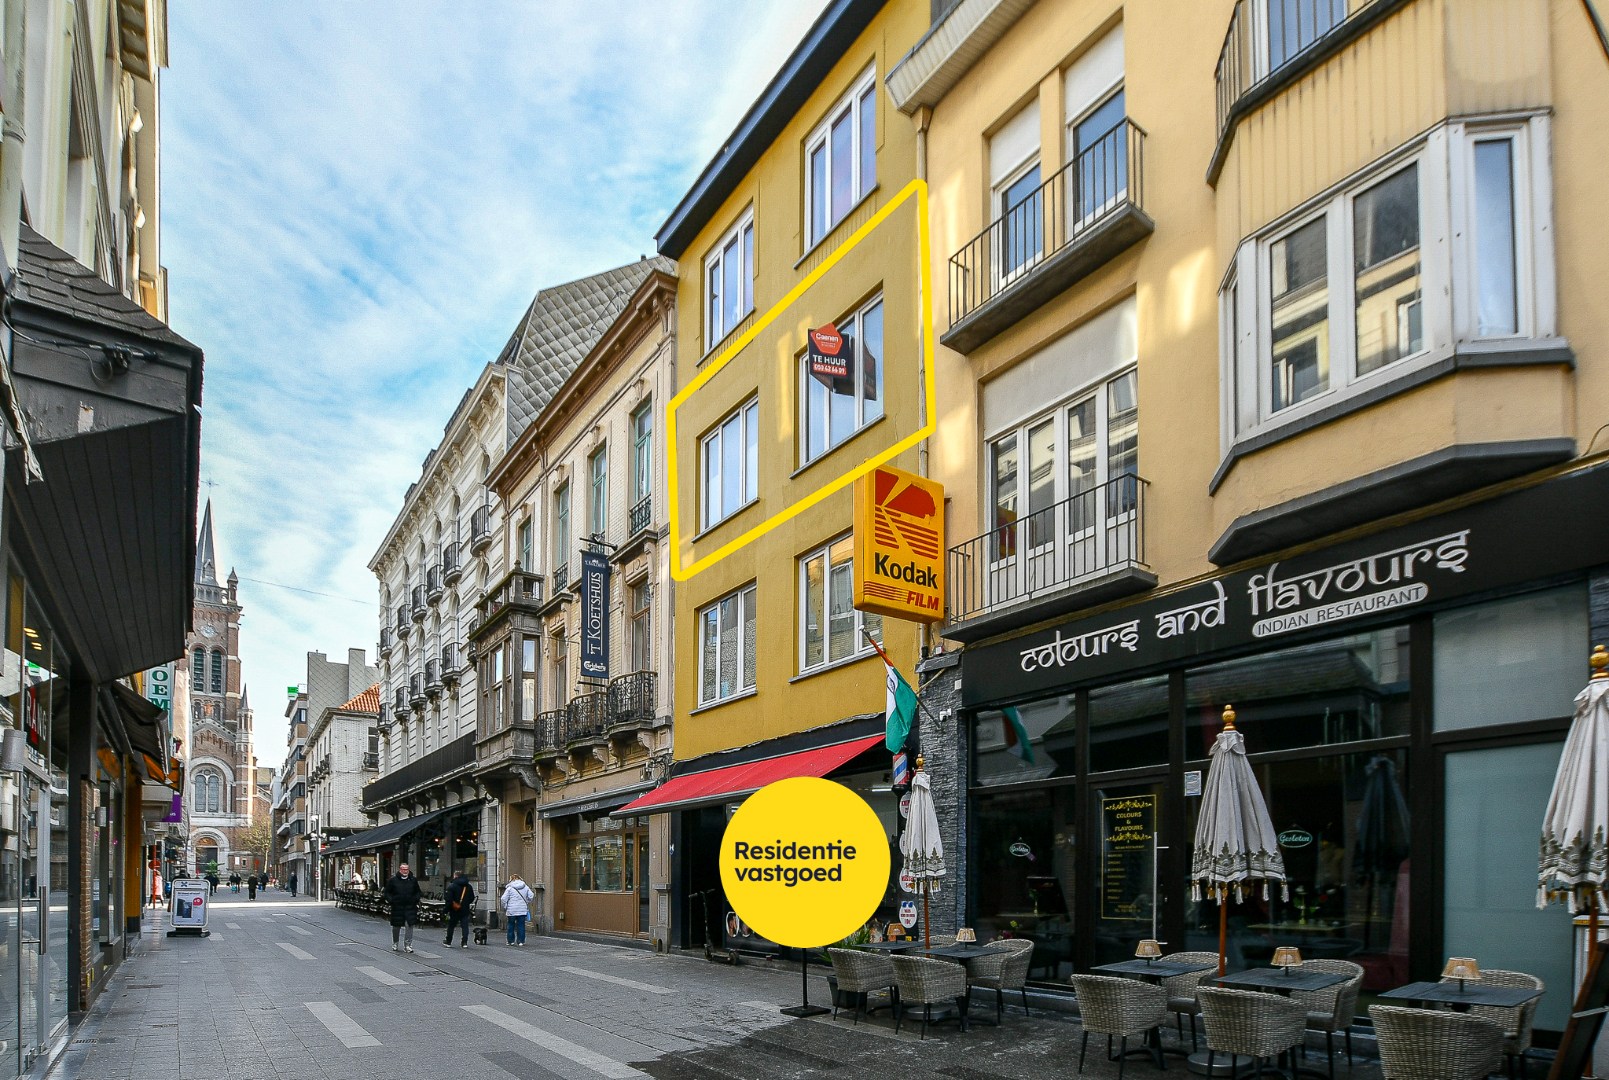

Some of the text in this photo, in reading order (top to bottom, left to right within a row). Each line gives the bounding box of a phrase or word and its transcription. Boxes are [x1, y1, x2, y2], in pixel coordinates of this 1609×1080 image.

[812, 354, 846, 366] TE HUUR
[875, 552, 938, 590] Kodak
[906, 590, 939, 611] FILM
[1020, 528, 1471, 672] colours and flavours
[1257, 585, 1423, 636] INDIAN RESTAURANT
[1116, 811, 1142, 819] COLOURS
